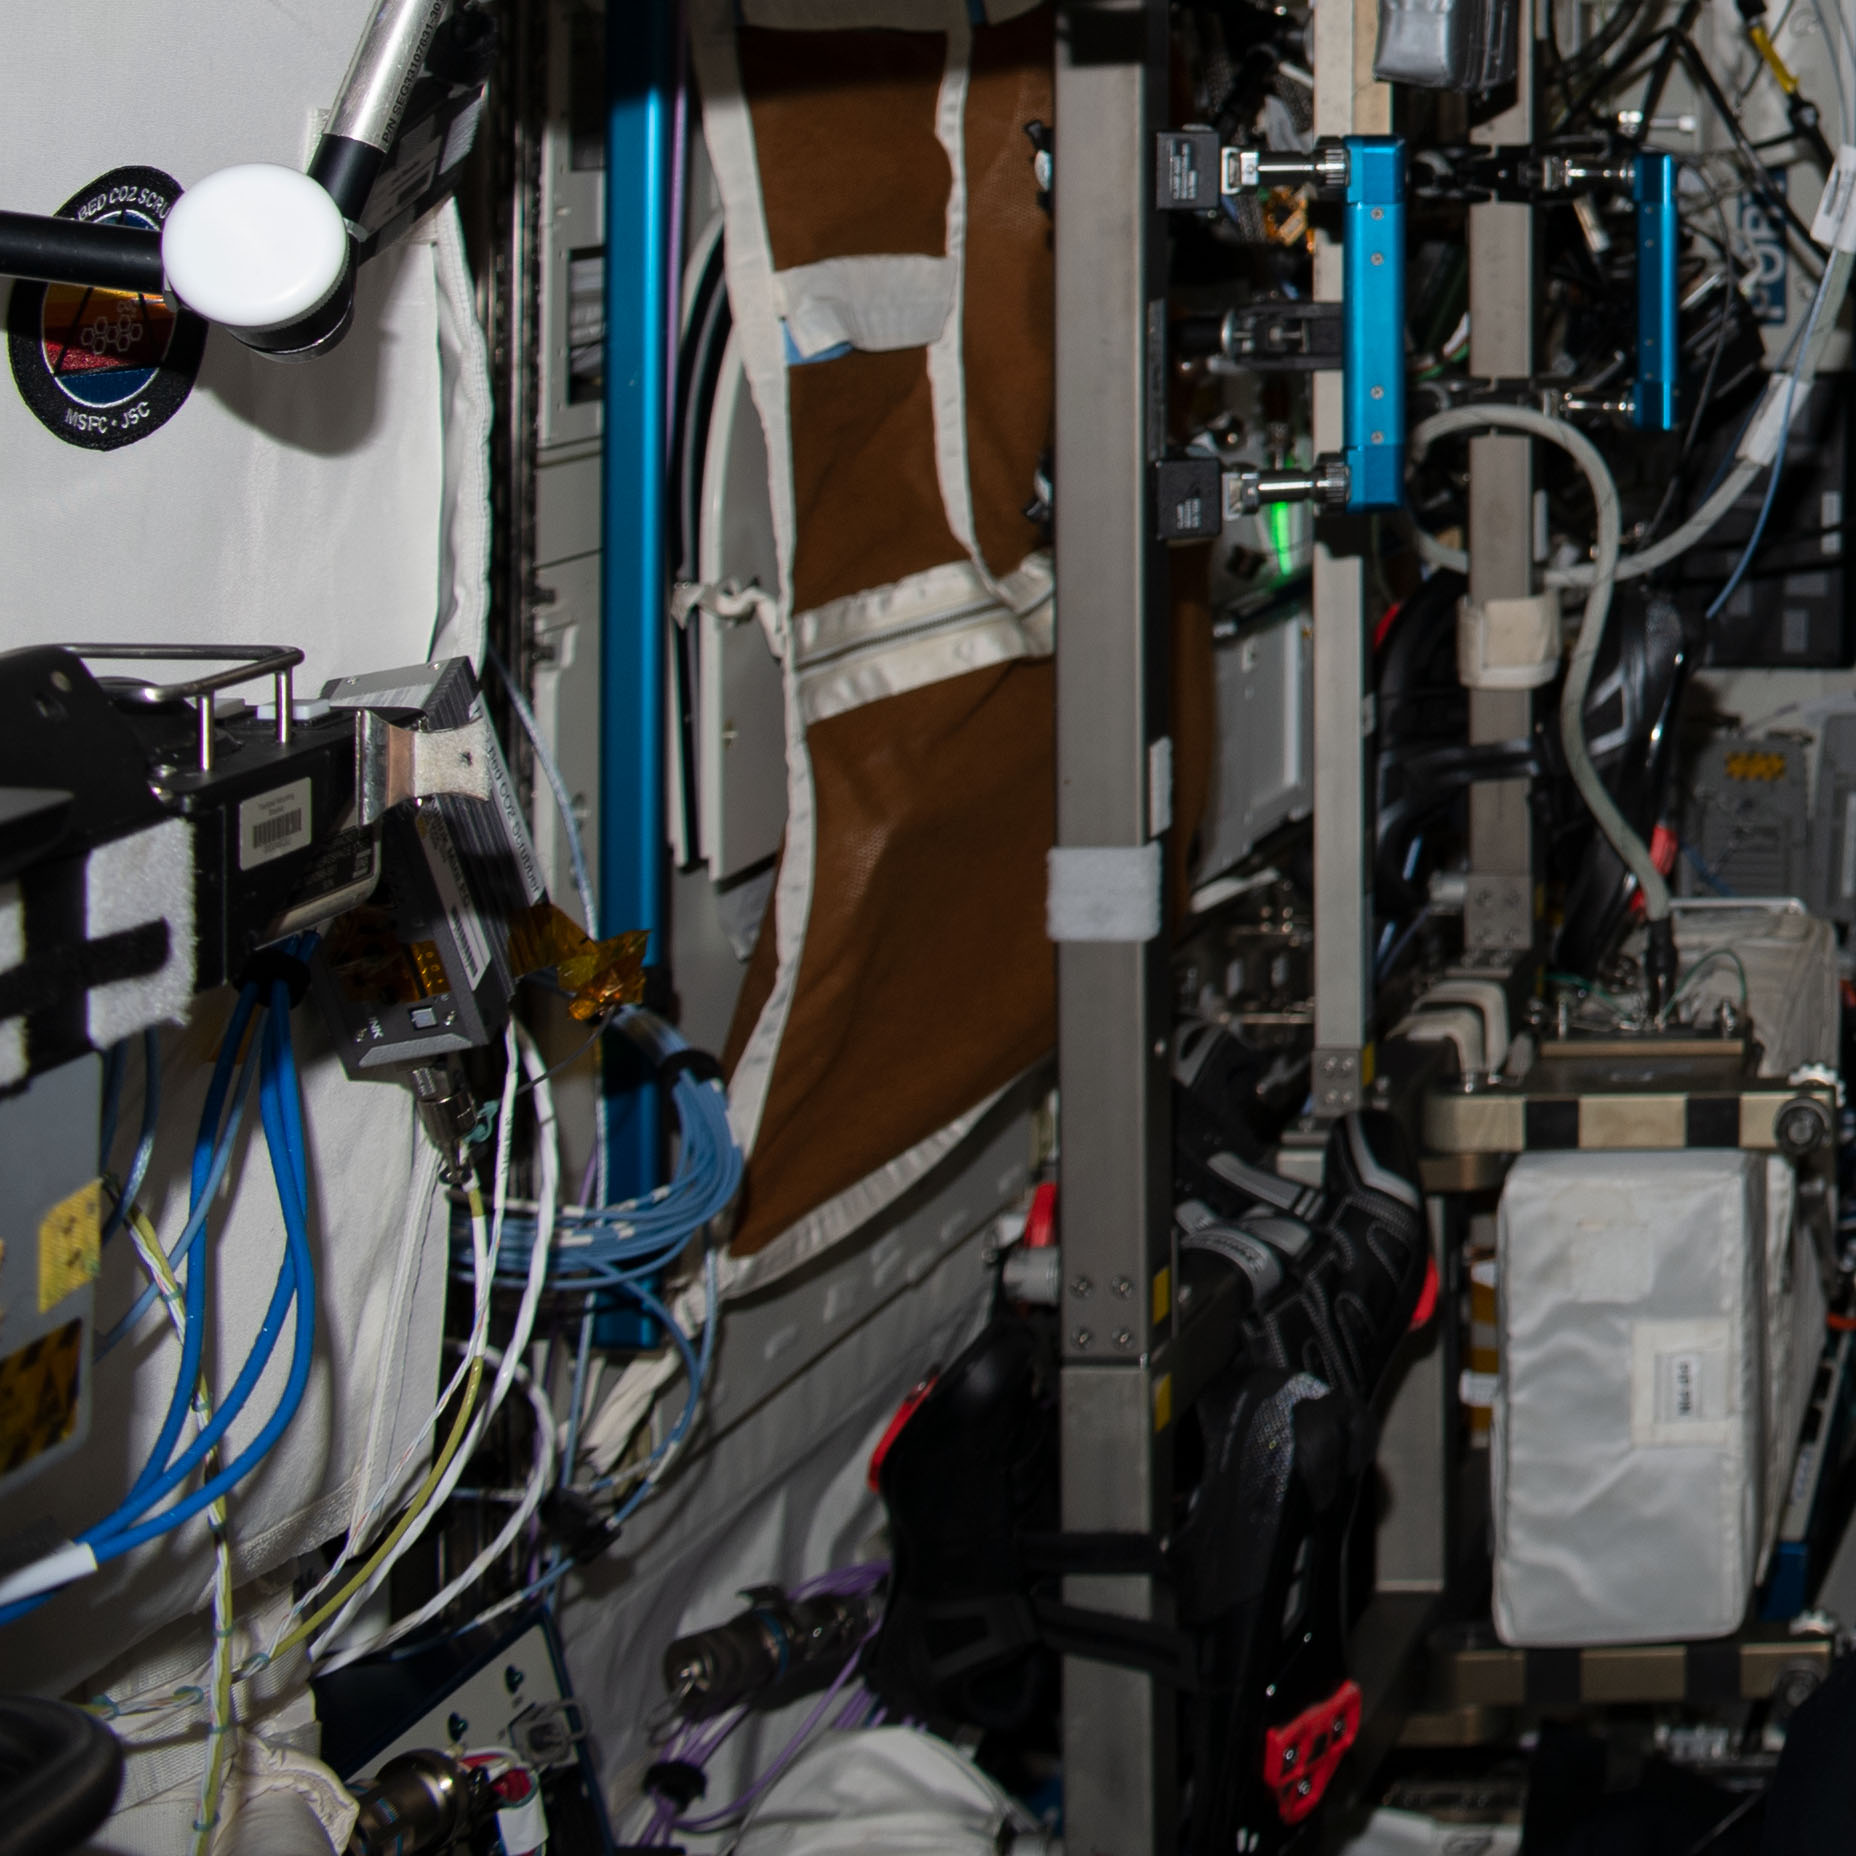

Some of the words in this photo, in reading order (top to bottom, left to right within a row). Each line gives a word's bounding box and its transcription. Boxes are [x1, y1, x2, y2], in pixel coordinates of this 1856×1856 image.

[380, 117, 397, 143] P/N
[77, 193, 106, 222] BED
[109, 184, 136, 204] CO2
[65, 407, 108, 433] MSFC
[120, 401, 150, 428] JSC
[496, 783, 516, 819] CO2
[510, 826, 542, 893] Scrubber
